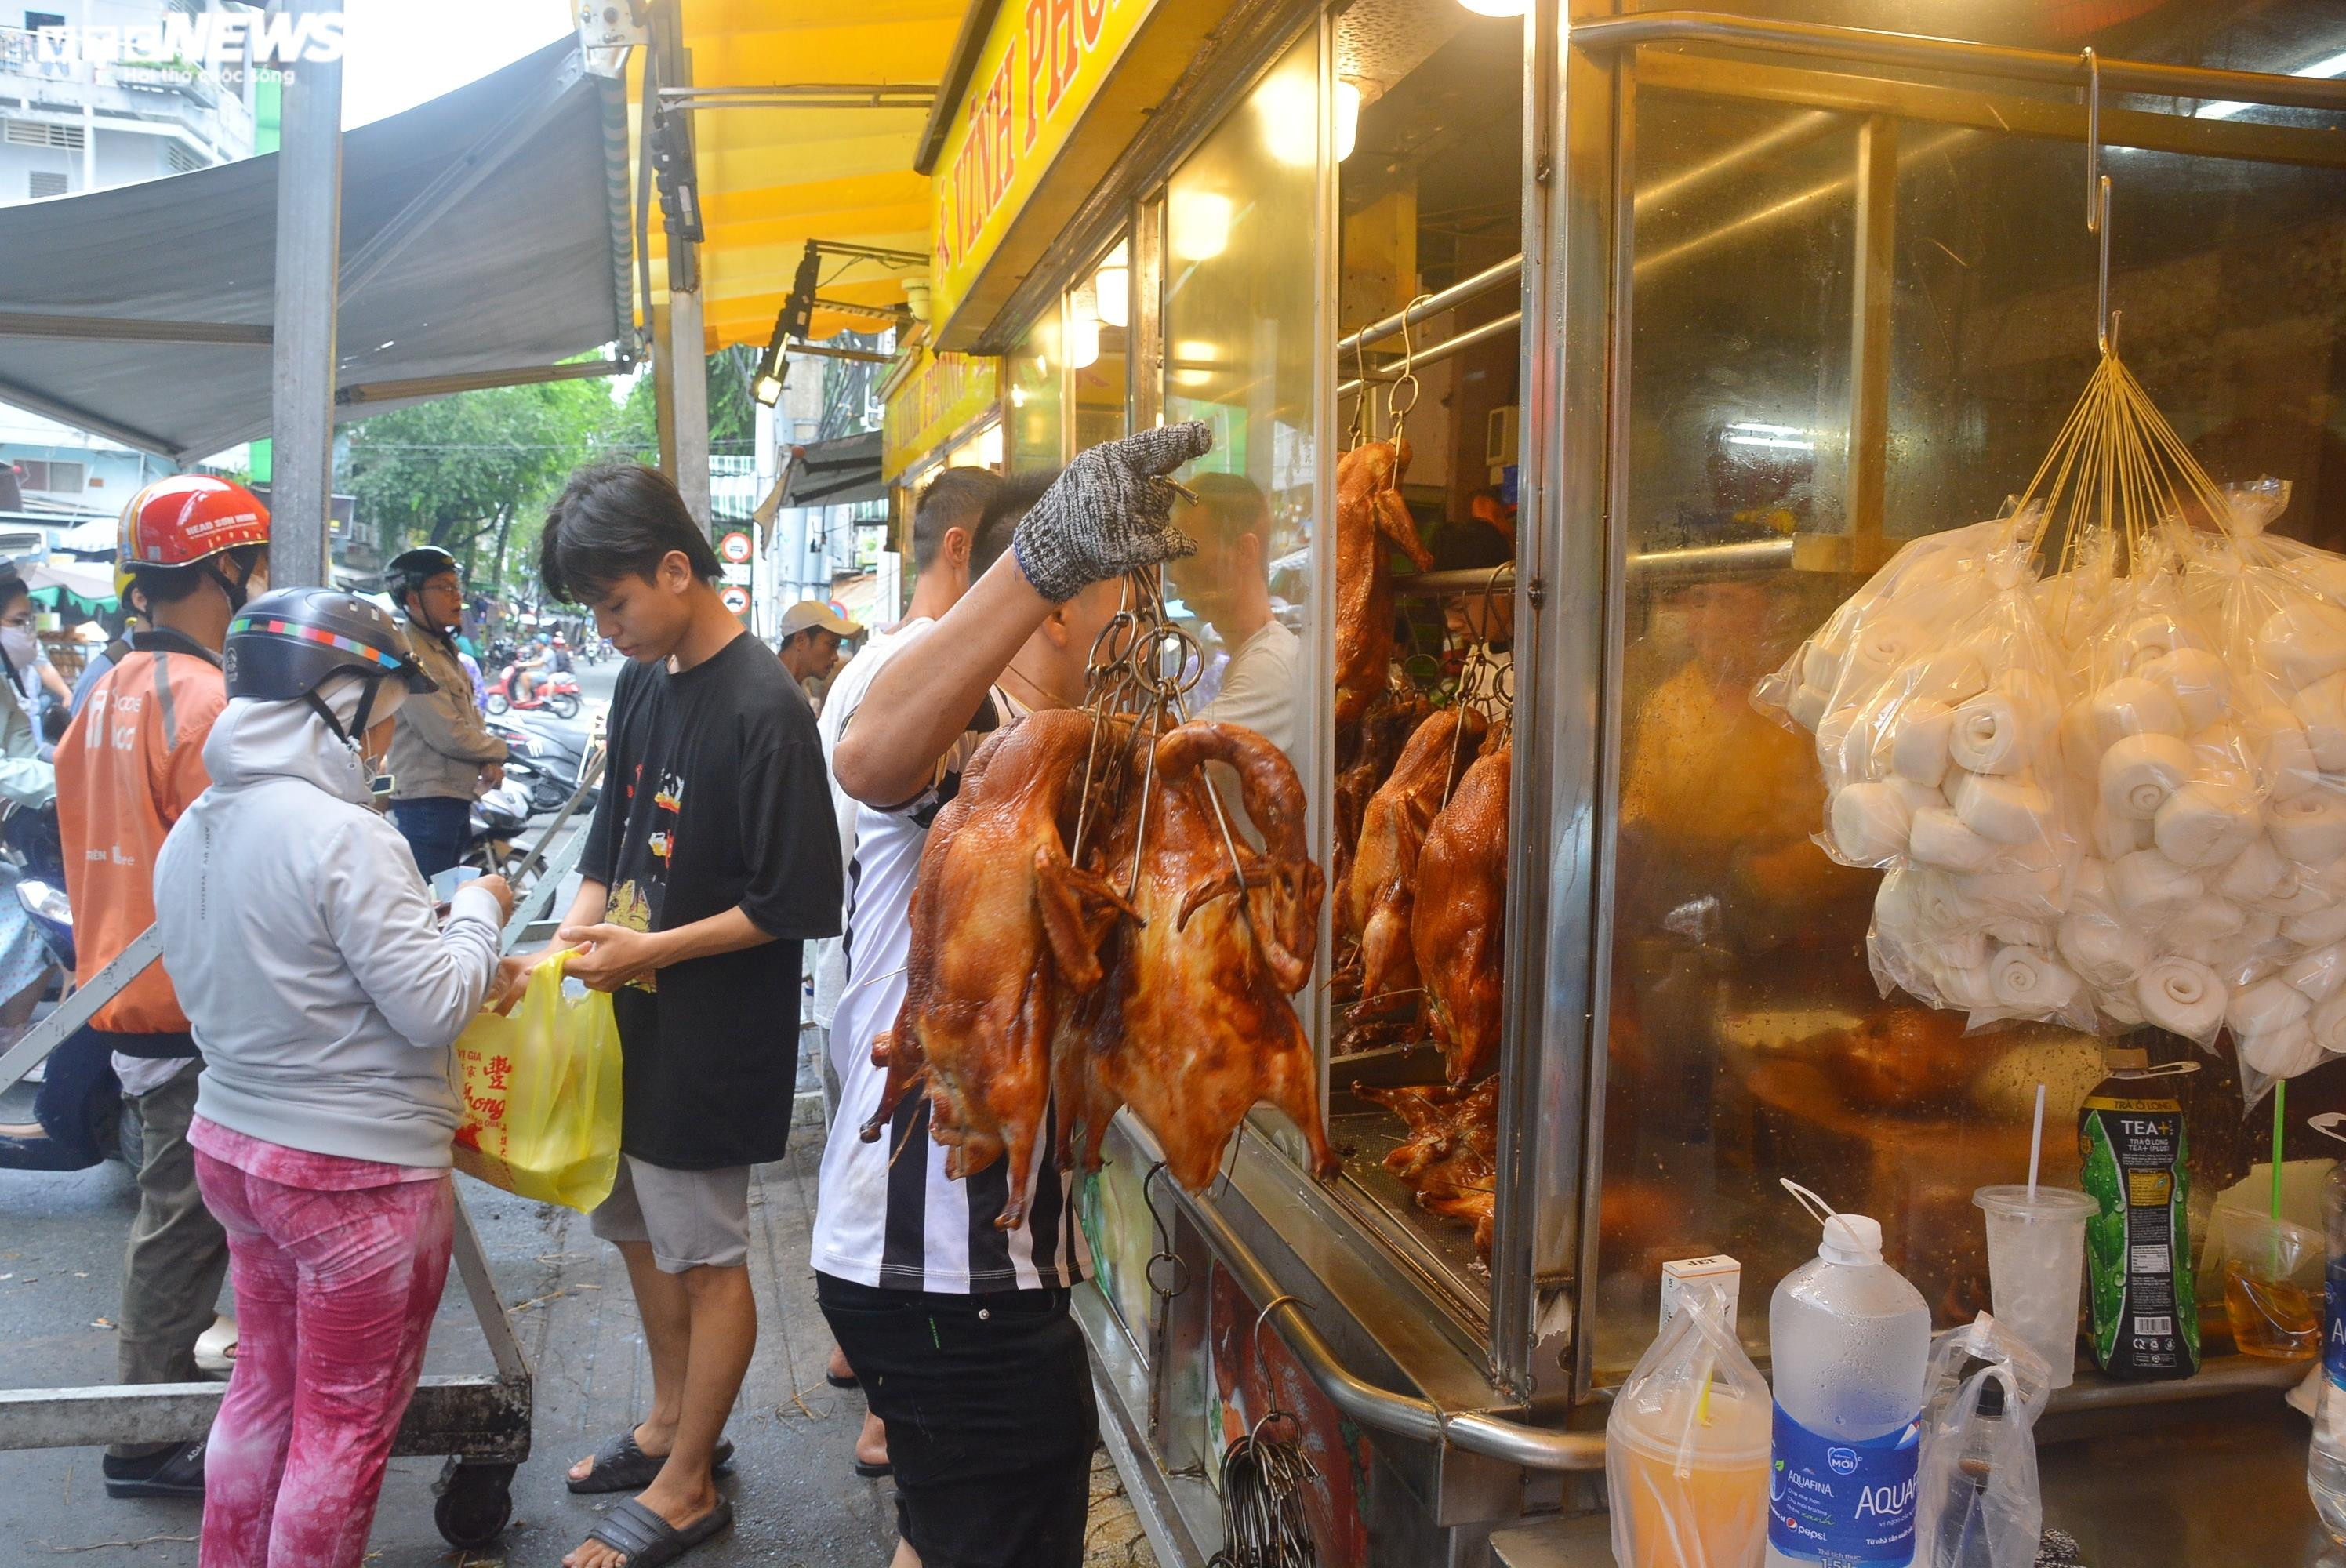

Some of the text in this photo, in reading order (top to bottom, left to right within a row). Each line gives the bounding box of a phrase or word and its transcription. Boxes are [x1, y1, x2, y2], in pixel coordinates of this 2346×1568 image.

[2120, 1120, 2170, 1135] TEA+
[2331, 1317, 2346, 1345] A
[1788, 1469, 1835, 1498] AQUAFINA
